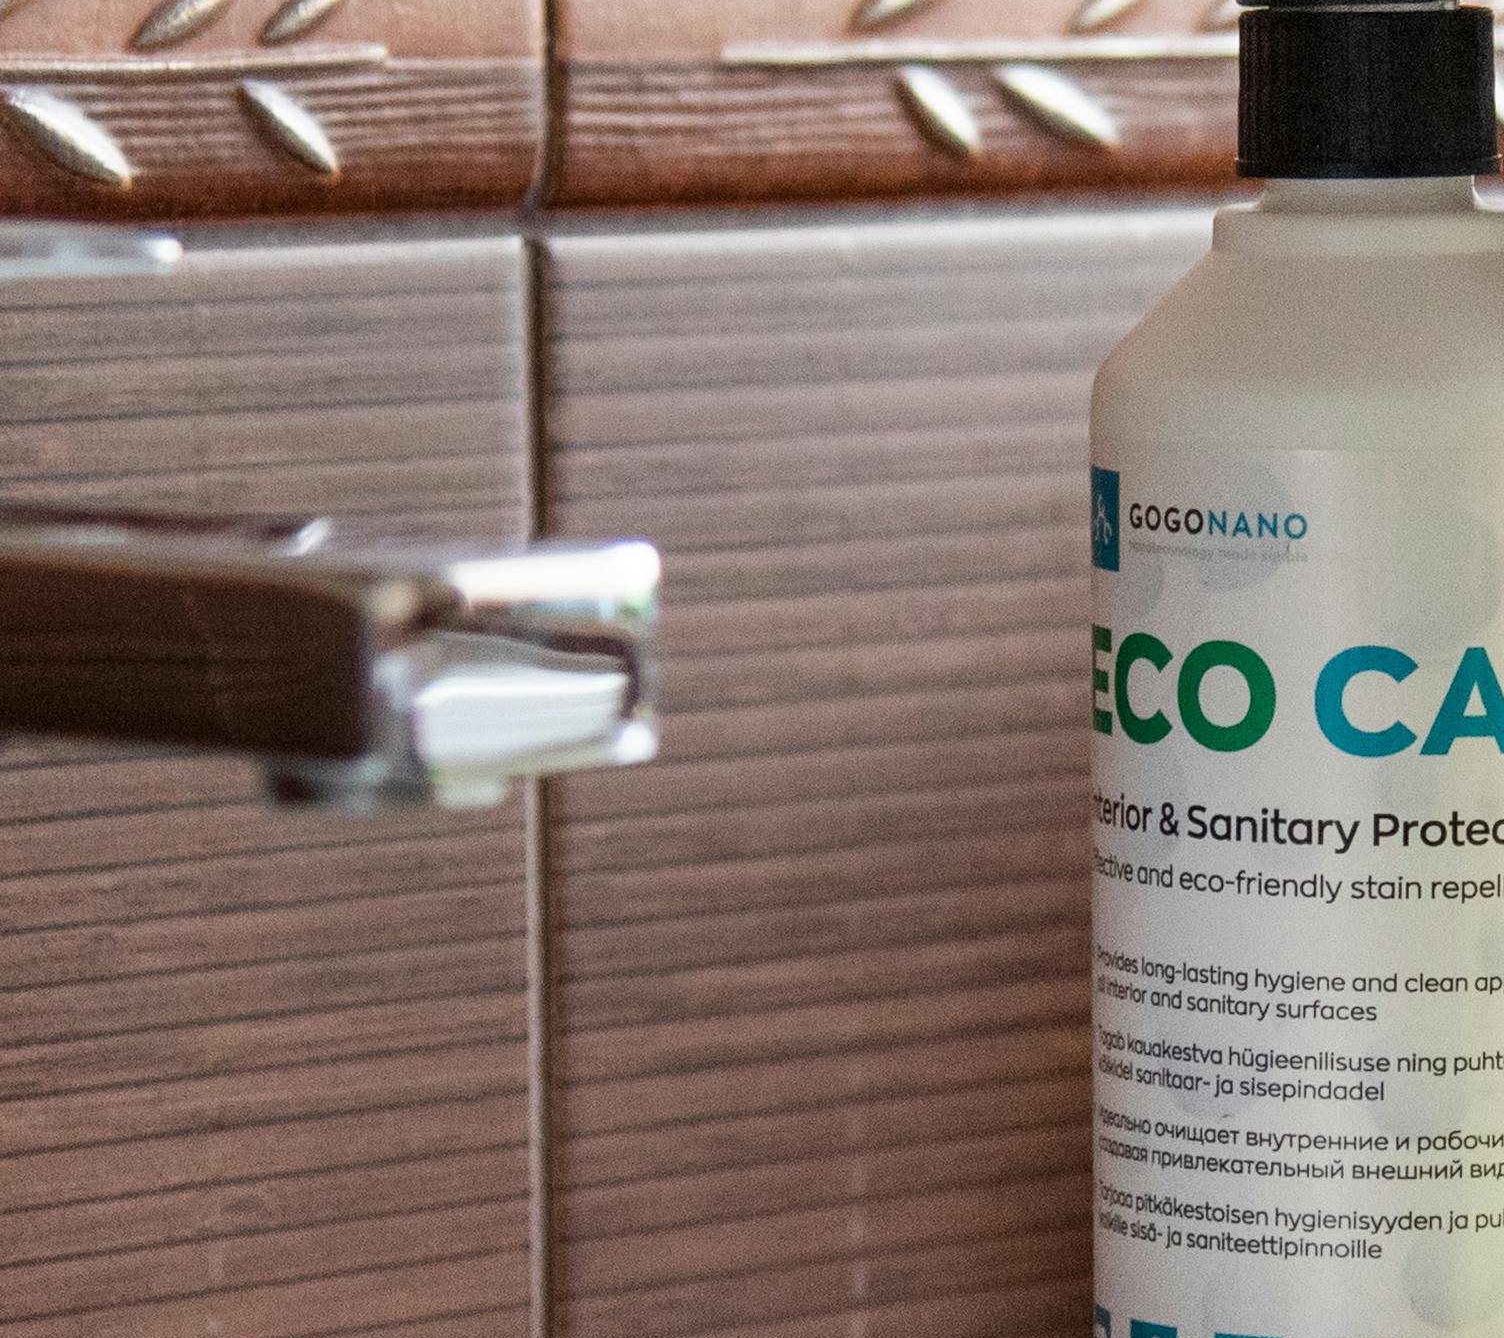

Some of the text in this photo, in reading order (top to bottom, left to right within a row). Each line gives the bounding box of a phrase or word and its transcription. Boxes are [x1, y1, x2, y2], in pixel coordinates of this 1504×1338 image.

[1129, 503, 1308, 540] GOGONANO
[1093, 788, 1153, 832] terior
[1160, 802, 1180, 837] &
[1187, 804, 1360, 854] Sanitary
[1093, 847, 1133, 882] ective
[1137, 864, 1173, 888] and
[1179, 870, 1342, 904] eco-friendly
[1350, 870, 1422, 901] stain
[1141, 957, 1248, 991] long-lasting
[1255, 968, 1346, 994] hygiene
[1352, 973, 1398, 993] and
[1404, 973, 1469, 993] clean
[1150, 990, 1182, 1010] and
[1187, 995, 1270, 1021] sanitary
[1276, 999, 1377, 1022] surfaces
[1127, 1033, 1223, 1065] kauakestva
[1229, 1046, 1391, 1073] hügieenilisuse
[1397, 1053, 1447, 1076] ning
[1136, 1066, 1211, 1092] sanitaar-
[1214, 1074, 1234, 1097] ja
[1239, 1078, 1385, 1101] sisepindadel
[1155, 1121, 1240, 1145] очищает
[1246, 1131, 1389, 1152] внутренние
[1396, 1135, 1410, 1151] и
[1151, 1150, 1344, 1178] привлекательный
[1352, 1160, 1463, 1180] внешний
[1136, 1193, 1268, 1224] pitkäkestoisen
[1275, 1207, 1442, 1234] hygienisyyden
[1447, 1210, 1469, 1234] ja
[1166, 1225, 1182, 1248] ja
[1187, 1232, 1383, 1259] saniteettipinnoille
